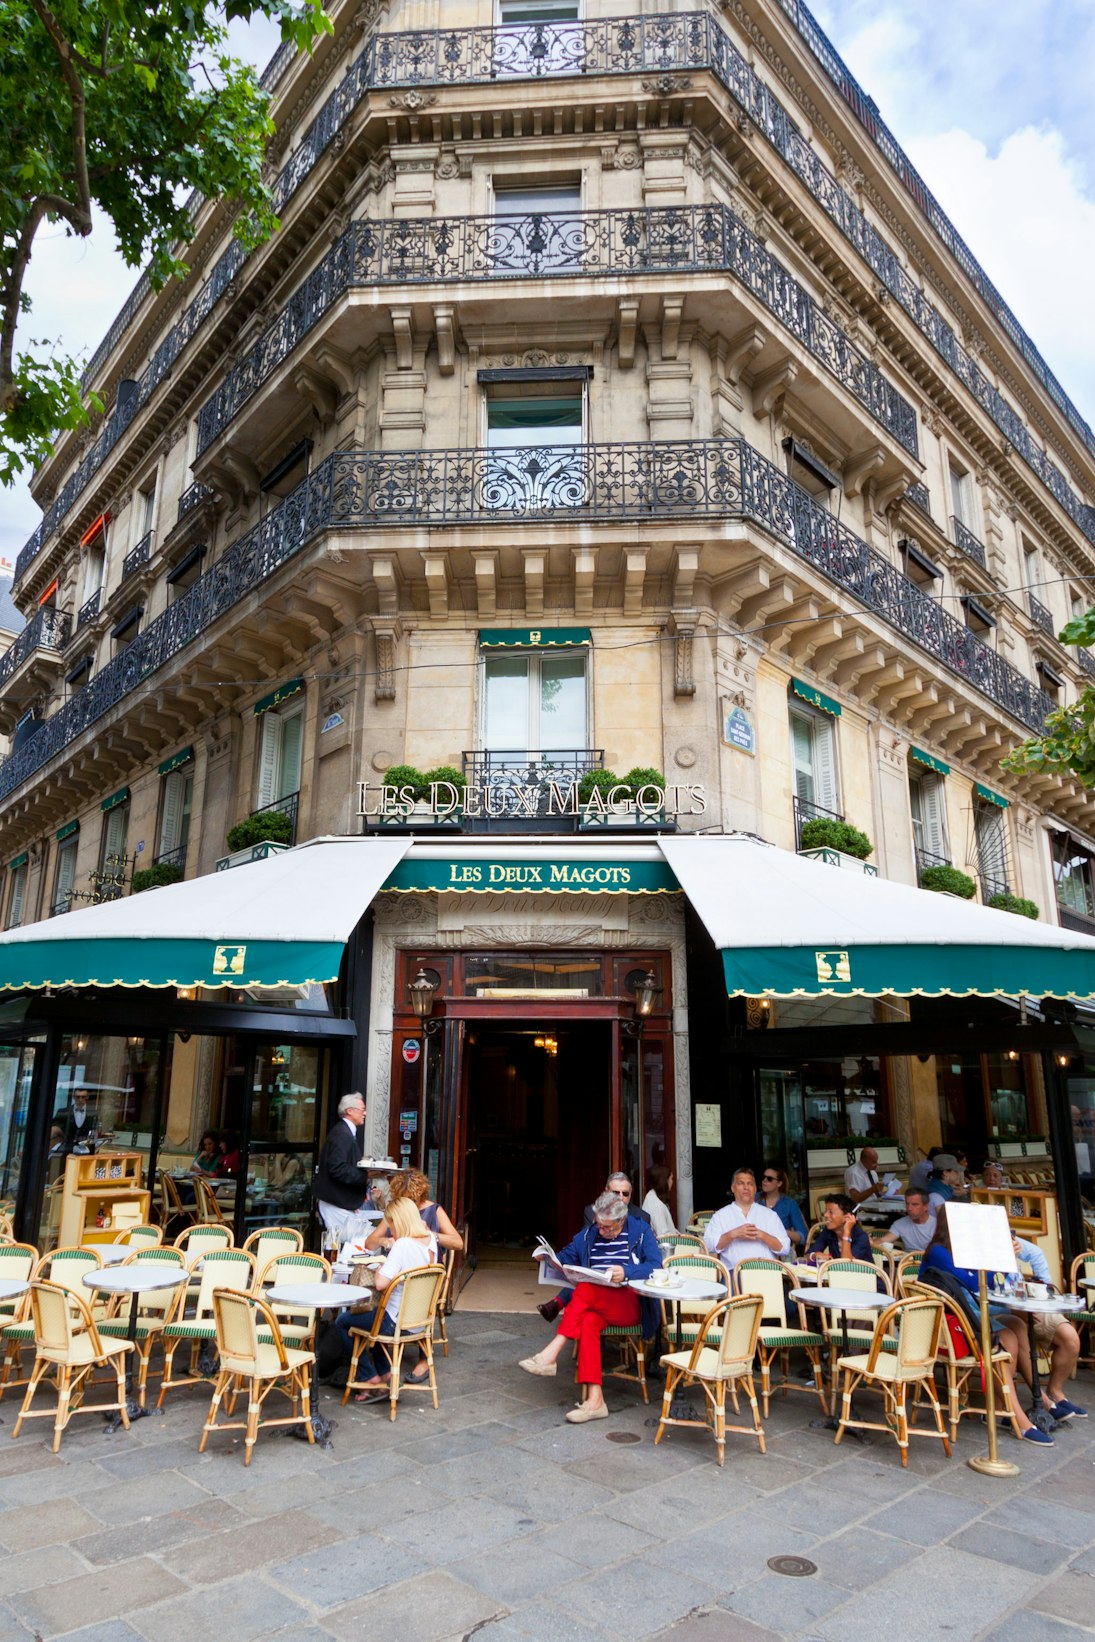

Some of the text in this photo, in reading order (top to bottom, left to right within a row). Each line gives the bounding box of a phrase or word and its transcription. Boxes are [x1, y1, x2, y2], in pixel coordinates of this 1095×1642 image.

[356, 780, 708, 816] LES DEUX MAGOTS
[449, 864, 631, 883] LES DEUX MAGOTS
